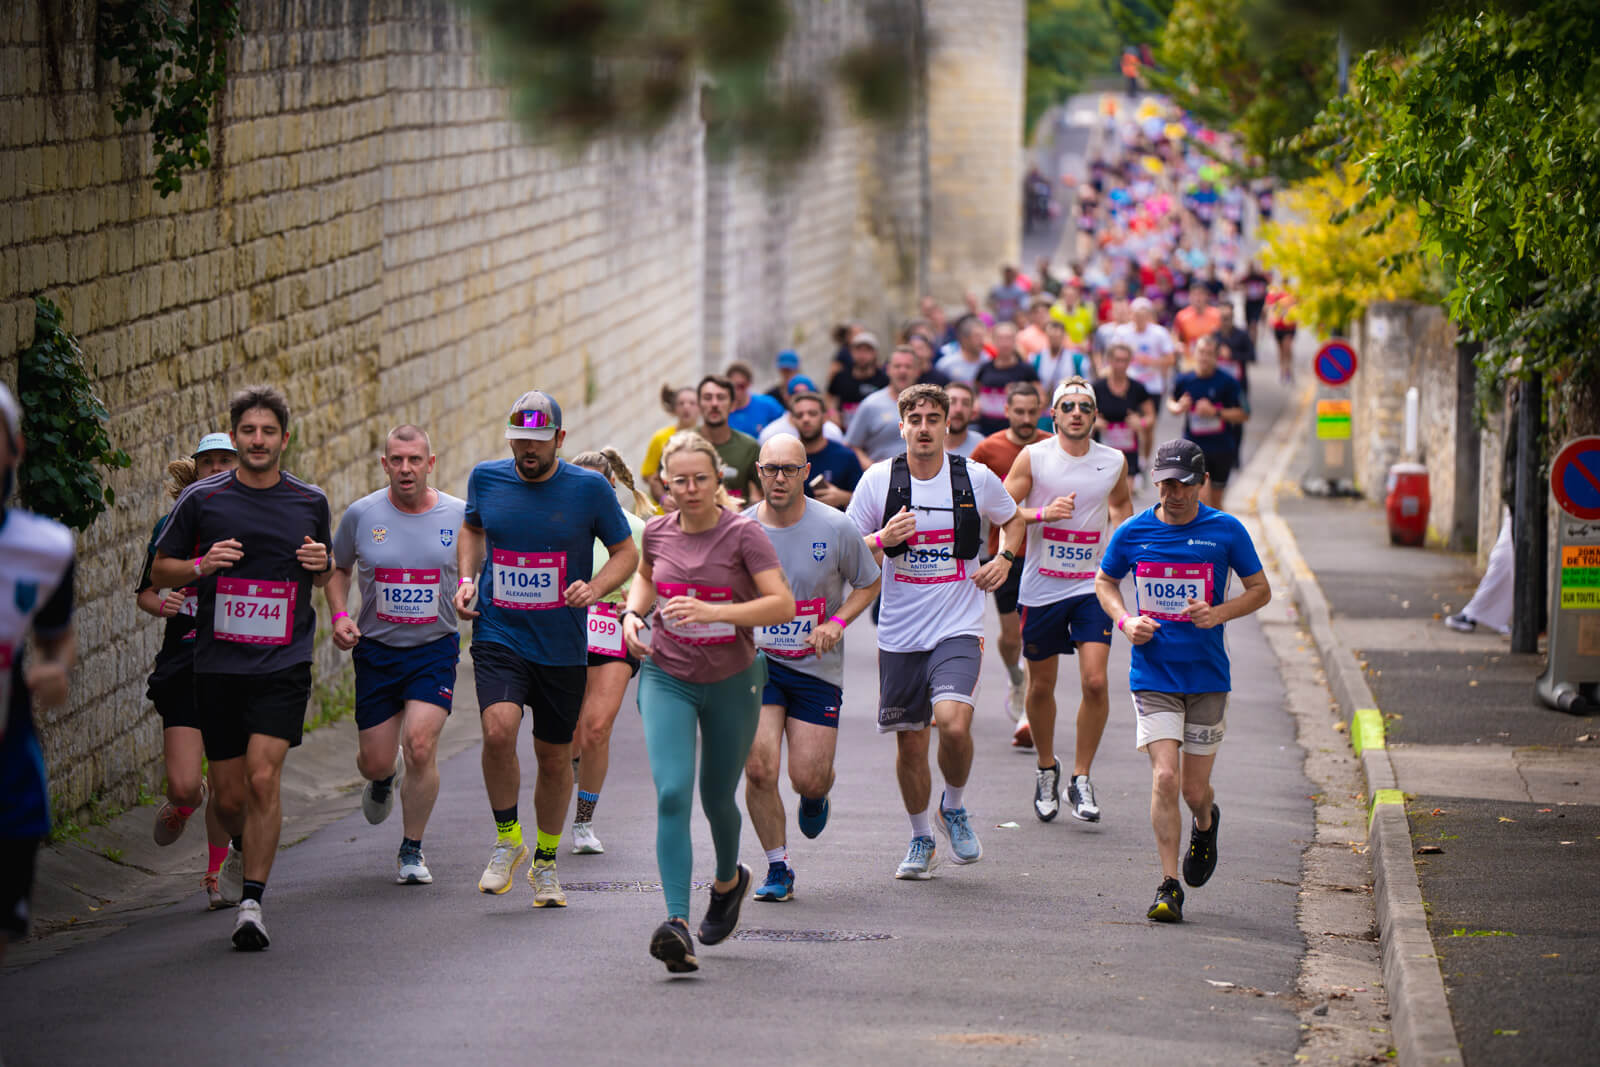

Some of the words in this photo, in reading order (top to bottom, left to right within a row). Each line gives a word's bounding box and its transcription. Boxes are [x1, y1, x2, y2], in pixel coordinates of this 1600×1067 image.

[903, 547, 950, 564] 15896
[1048, 545, 1093, 560] 13556
[499, 570, 551, 588] 11043
[382, 588, 434, 603] 18223
[1145, 583, 1197, 598] 10843
[224, 600, 280, 620] 18744
[762, 620, 812, 635] 18574
[774, 637, 796, 645] JULIEN
